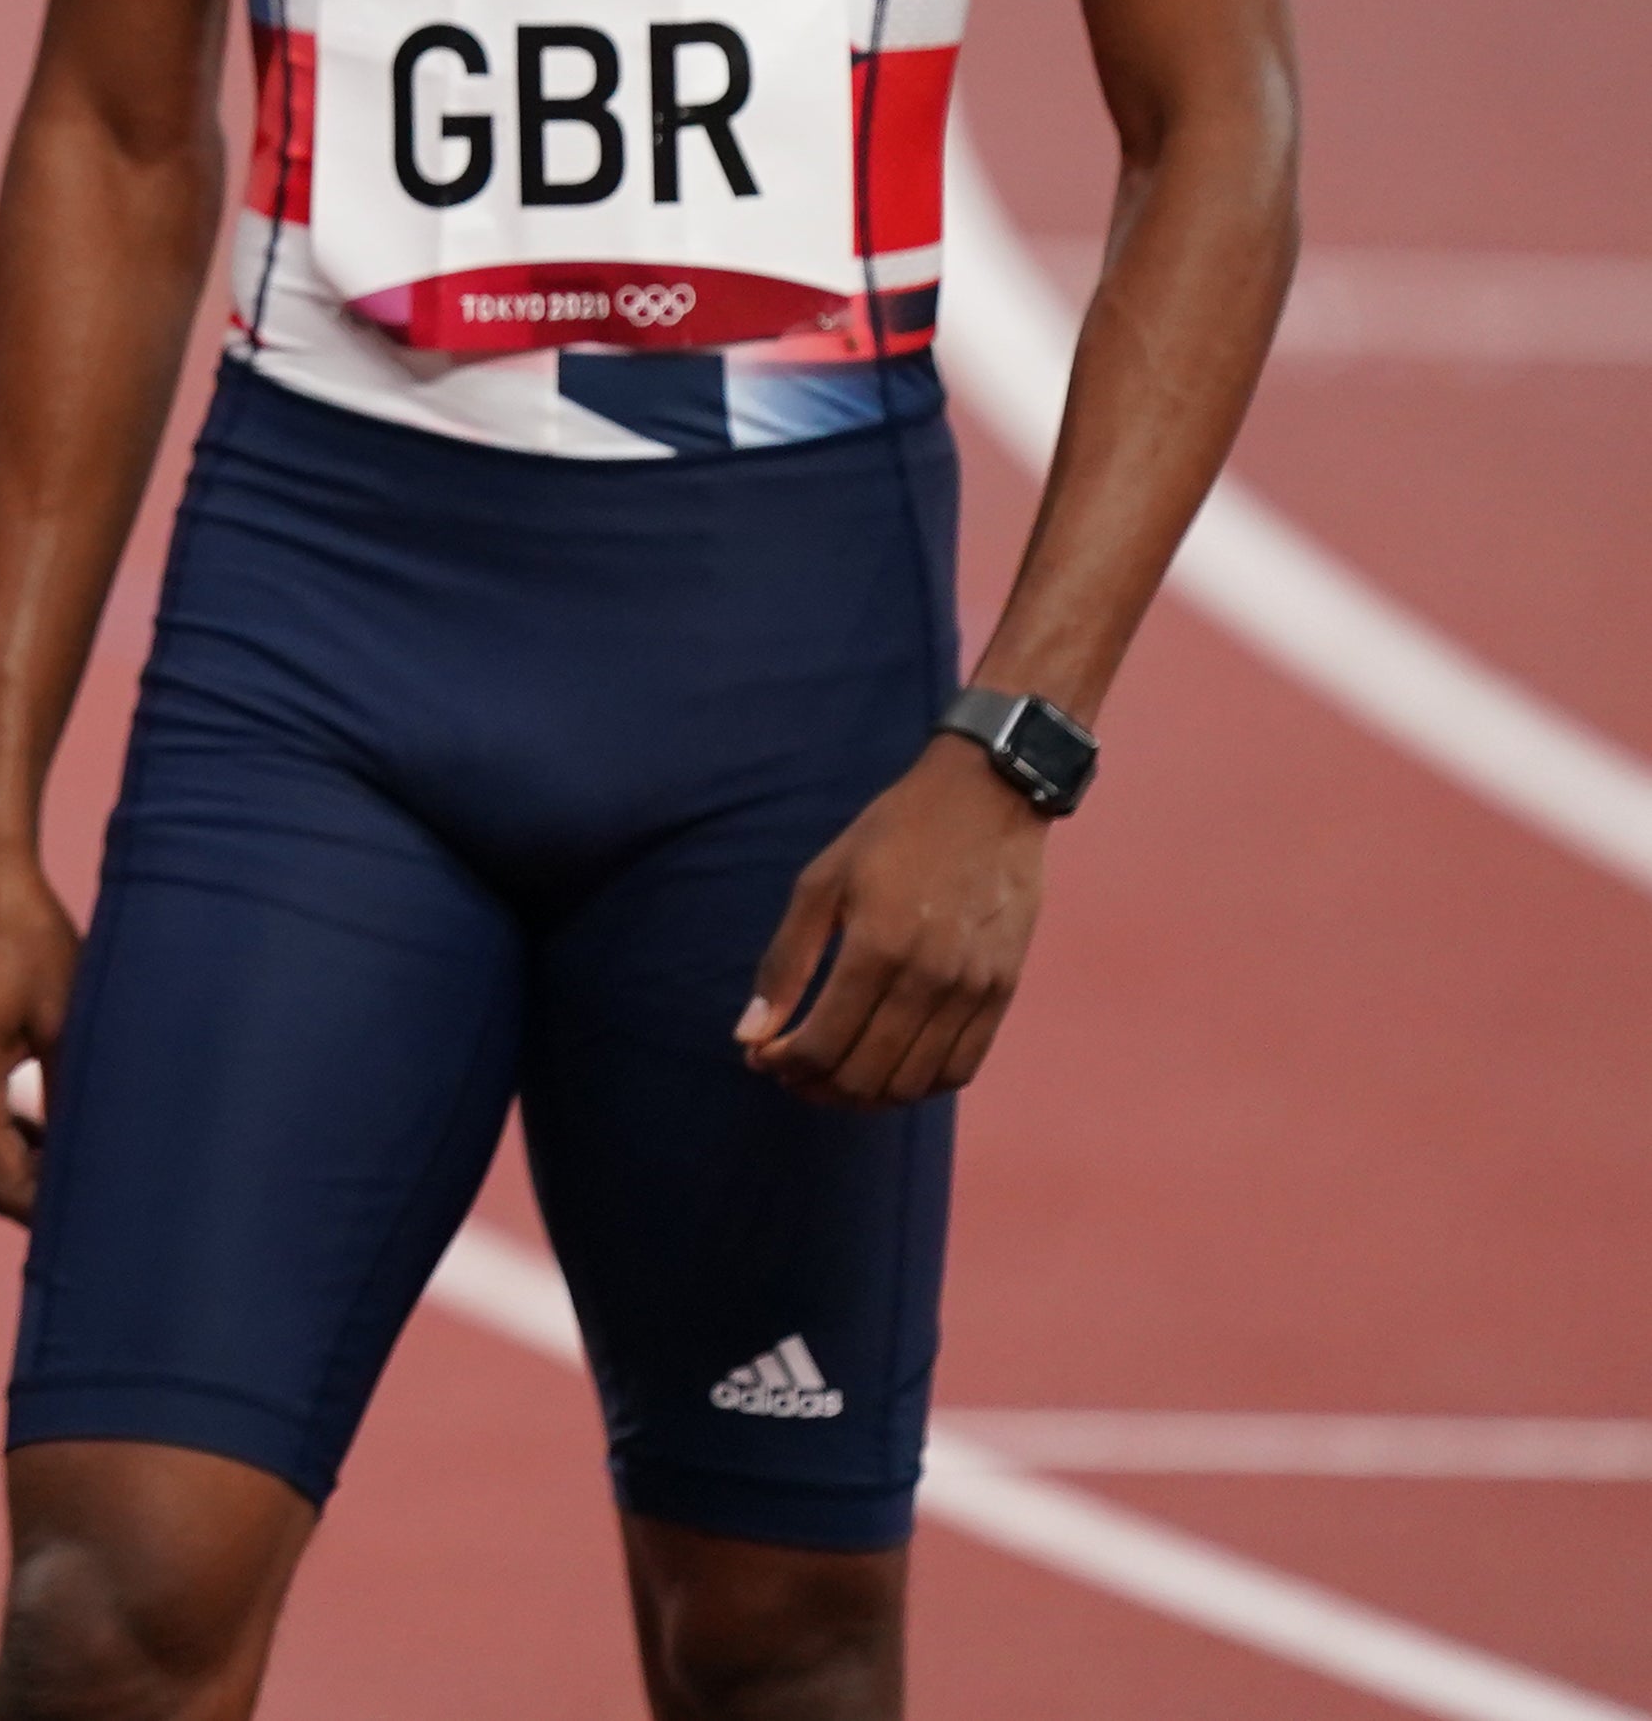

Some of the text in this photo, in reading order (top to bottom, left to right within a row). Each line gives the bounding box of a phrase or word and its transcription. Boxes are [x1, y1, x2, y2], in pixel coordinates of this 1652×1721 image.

[392, 20, 762, 208] GBR
[460, 292, 545, 323] TOKYO
[708, 1380, 844, 1419] adidas
